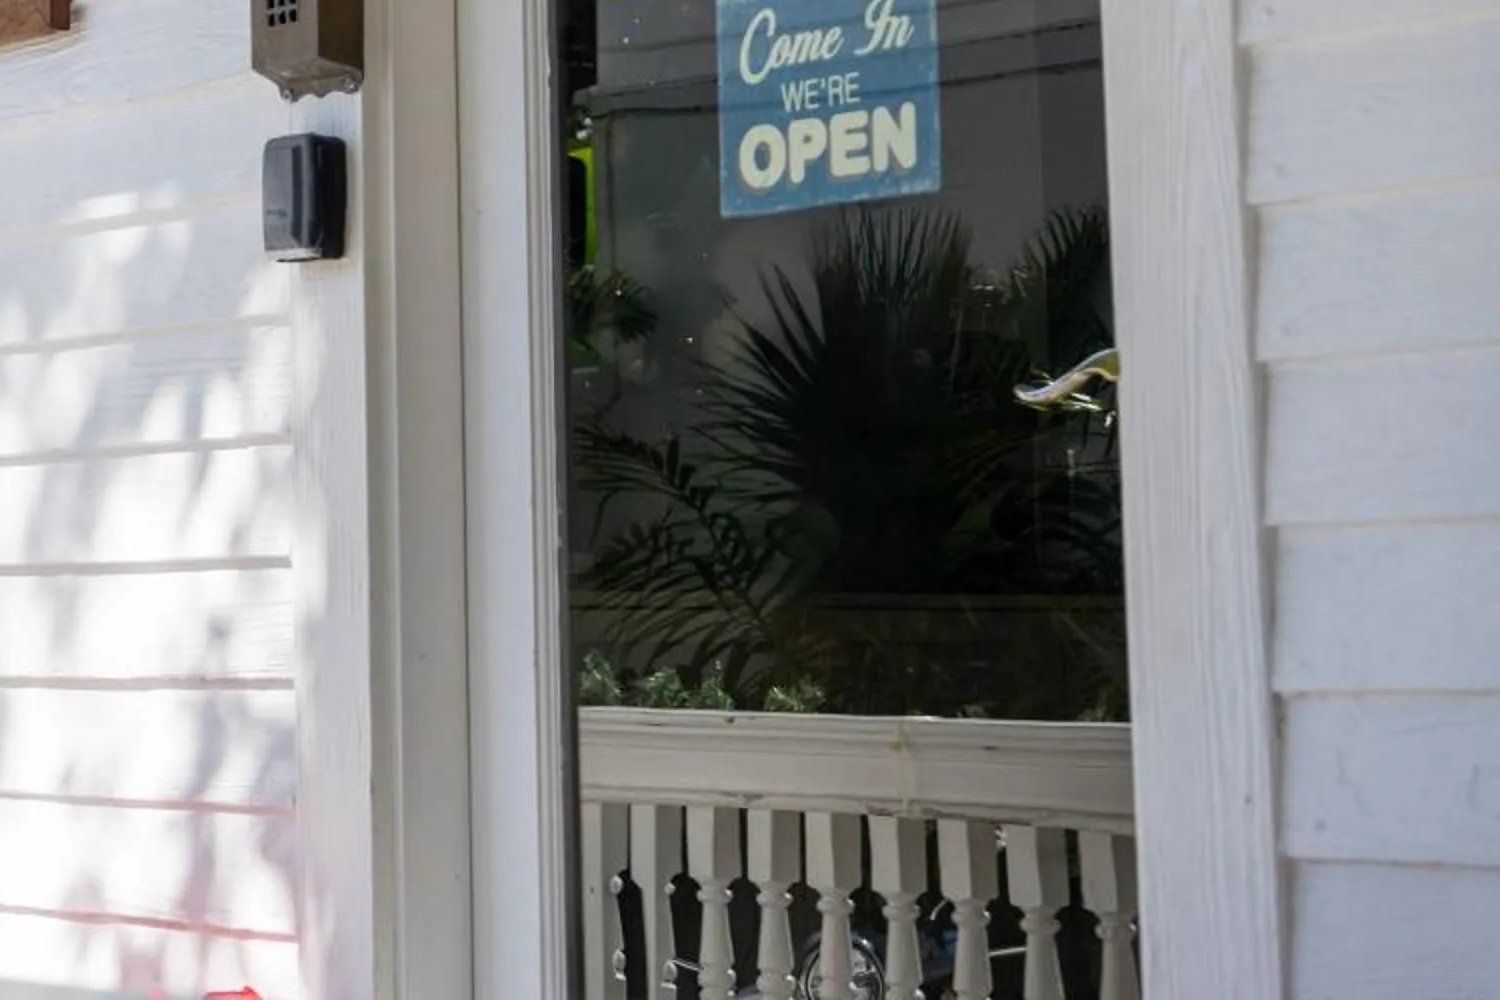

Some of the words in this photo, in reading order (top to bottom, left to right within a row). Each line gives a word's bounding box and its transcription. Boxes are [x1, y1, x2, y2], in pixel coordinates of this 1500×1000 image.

[739, 7, 845, 85] Come
[780, 72, 862, 113] WE'RE
[738, 101, 918, 190] OPEN
